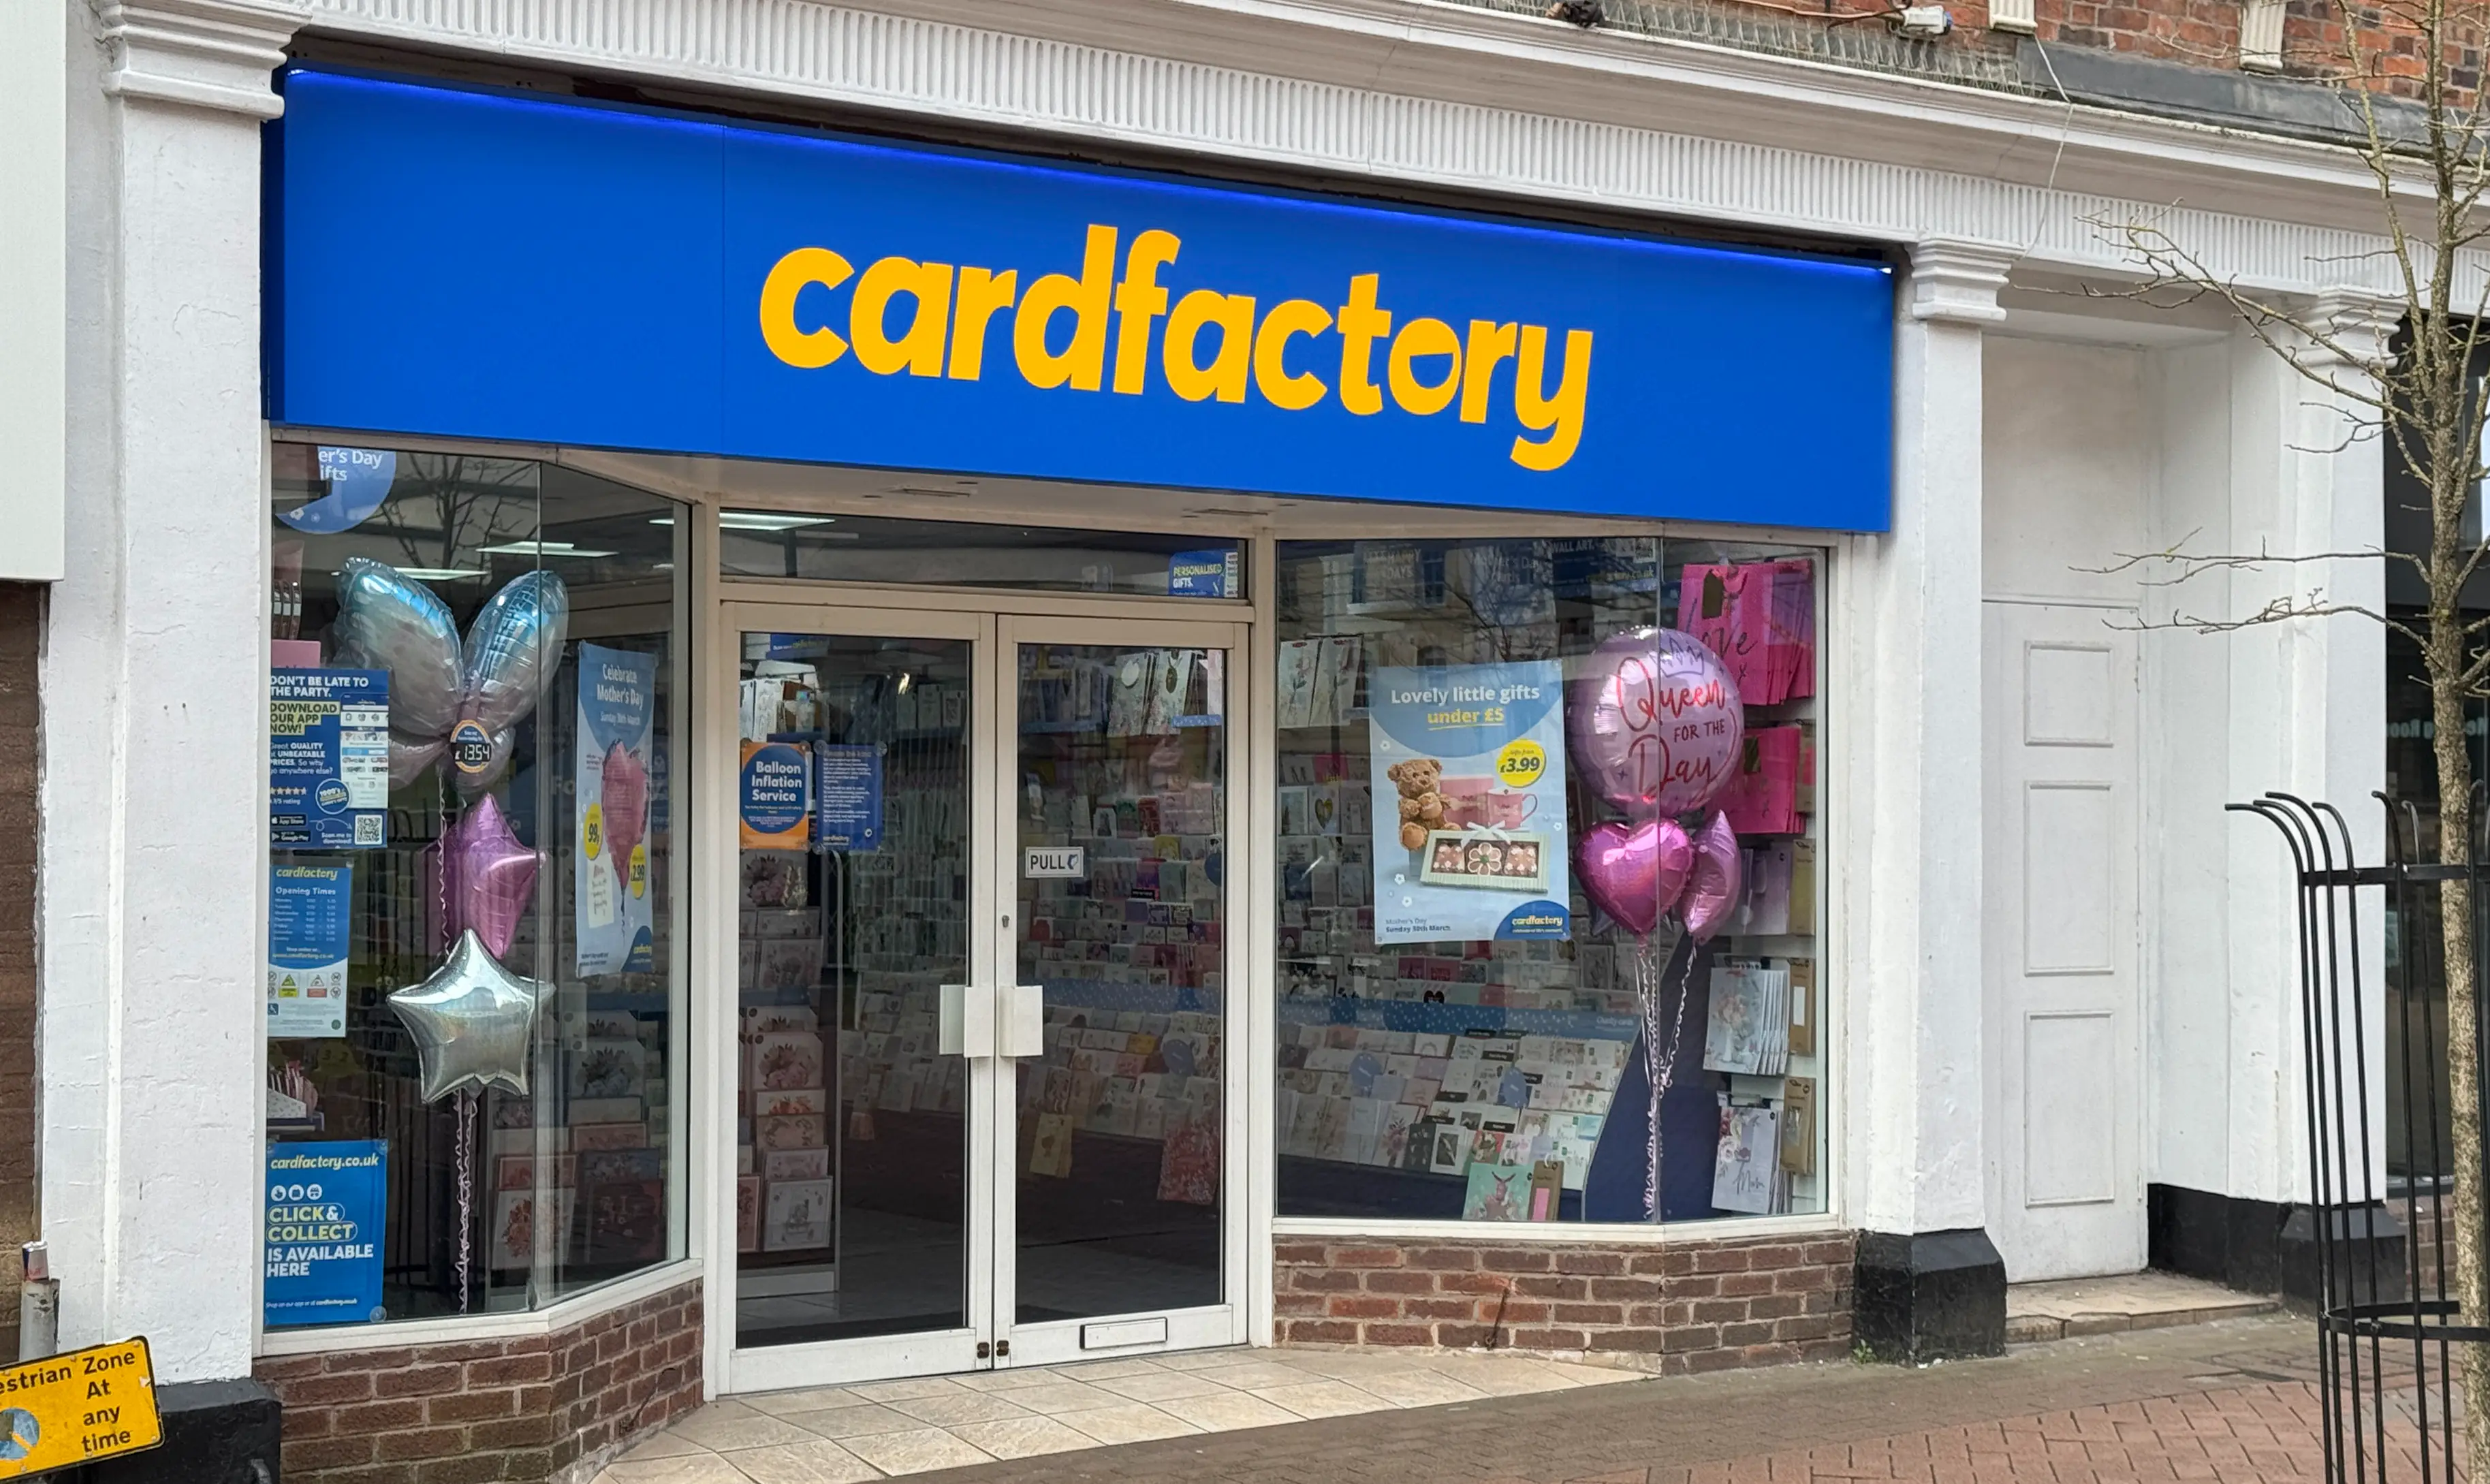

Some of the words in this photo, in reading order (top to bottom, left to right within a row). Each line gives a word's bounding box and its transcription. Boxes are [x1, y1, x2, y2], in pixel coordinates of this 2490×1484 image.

[759, 223, 1595, 472] cardfactory
[352, 450, 383, 469] Day
[1173, 563, 1223, 577] PERSONALISED
[270, 676, 306, 686] DON'T
[308, 676, 322, 686] BE
[324, 676, 351, 686] LATE
[353, 677, 369, 687] TO
[602, 663, 637, 684] Celebrate
[270, 686, 291, 697] THE
[294, 687, 332, 697] PARTY.
[597, 684, 629, 705] Mother's
[631, 689, 644, 710] Day
[1391, 687, 1449, 706] Lovely
[1453, 686, 1496, 702] little
[1500, 684, 1541, 704] gifts
[1616, 657, 1725, 732] Queen
[270, 703, 337, 713] DOWNLOAD
[1428, 708, 1480, 724] under
[1484, 708, 1505, 722] £5
[270, 714, 294, 724] OUR
[297, 714, 319, 723] APP
[270, 723, 302, 733] NOW!
[1674, 724, 1700, 742] FOR
[1703, 719, 1725, 736] THE
[756, 761, 801, 774] Balloon
[1500, 757, 1541, 773] £3.99
[1628, 734, 1730, 806] Day
[751, 775, 802, 788] Inflation
[752, 789, 797, 802] Service
[1030, 854, 1065, 870] PULL
[275, 866, 338, 881] cardfactory
[275, 886, 311, 896] Opening
[313, 887, 336, 896] Times
[1386, 925, 1411, 933] Sunday
[1512, 915, 1563, 927] cardfactory
[270, 1152, 379, 1171] cardfactory.co.uk
[268, 1206, 325, 1223] CLICK
[326, 1205, 338, 1221] &
[268, 1223, 355, 1242] COLLECT
[268, 1247, 283, 1263] IS
[286, 1244, 374, 1262] AVAILABLE
[266, 1262, 311, 1278] HERE
[0, 1366, 72, 1394] estrian
[82, 1351, 136, 1376] Zone
[86, 1380, 112, 1400] At
[83, 1405, 121, 1427] any
[82, 1430, 131, 1453] time
